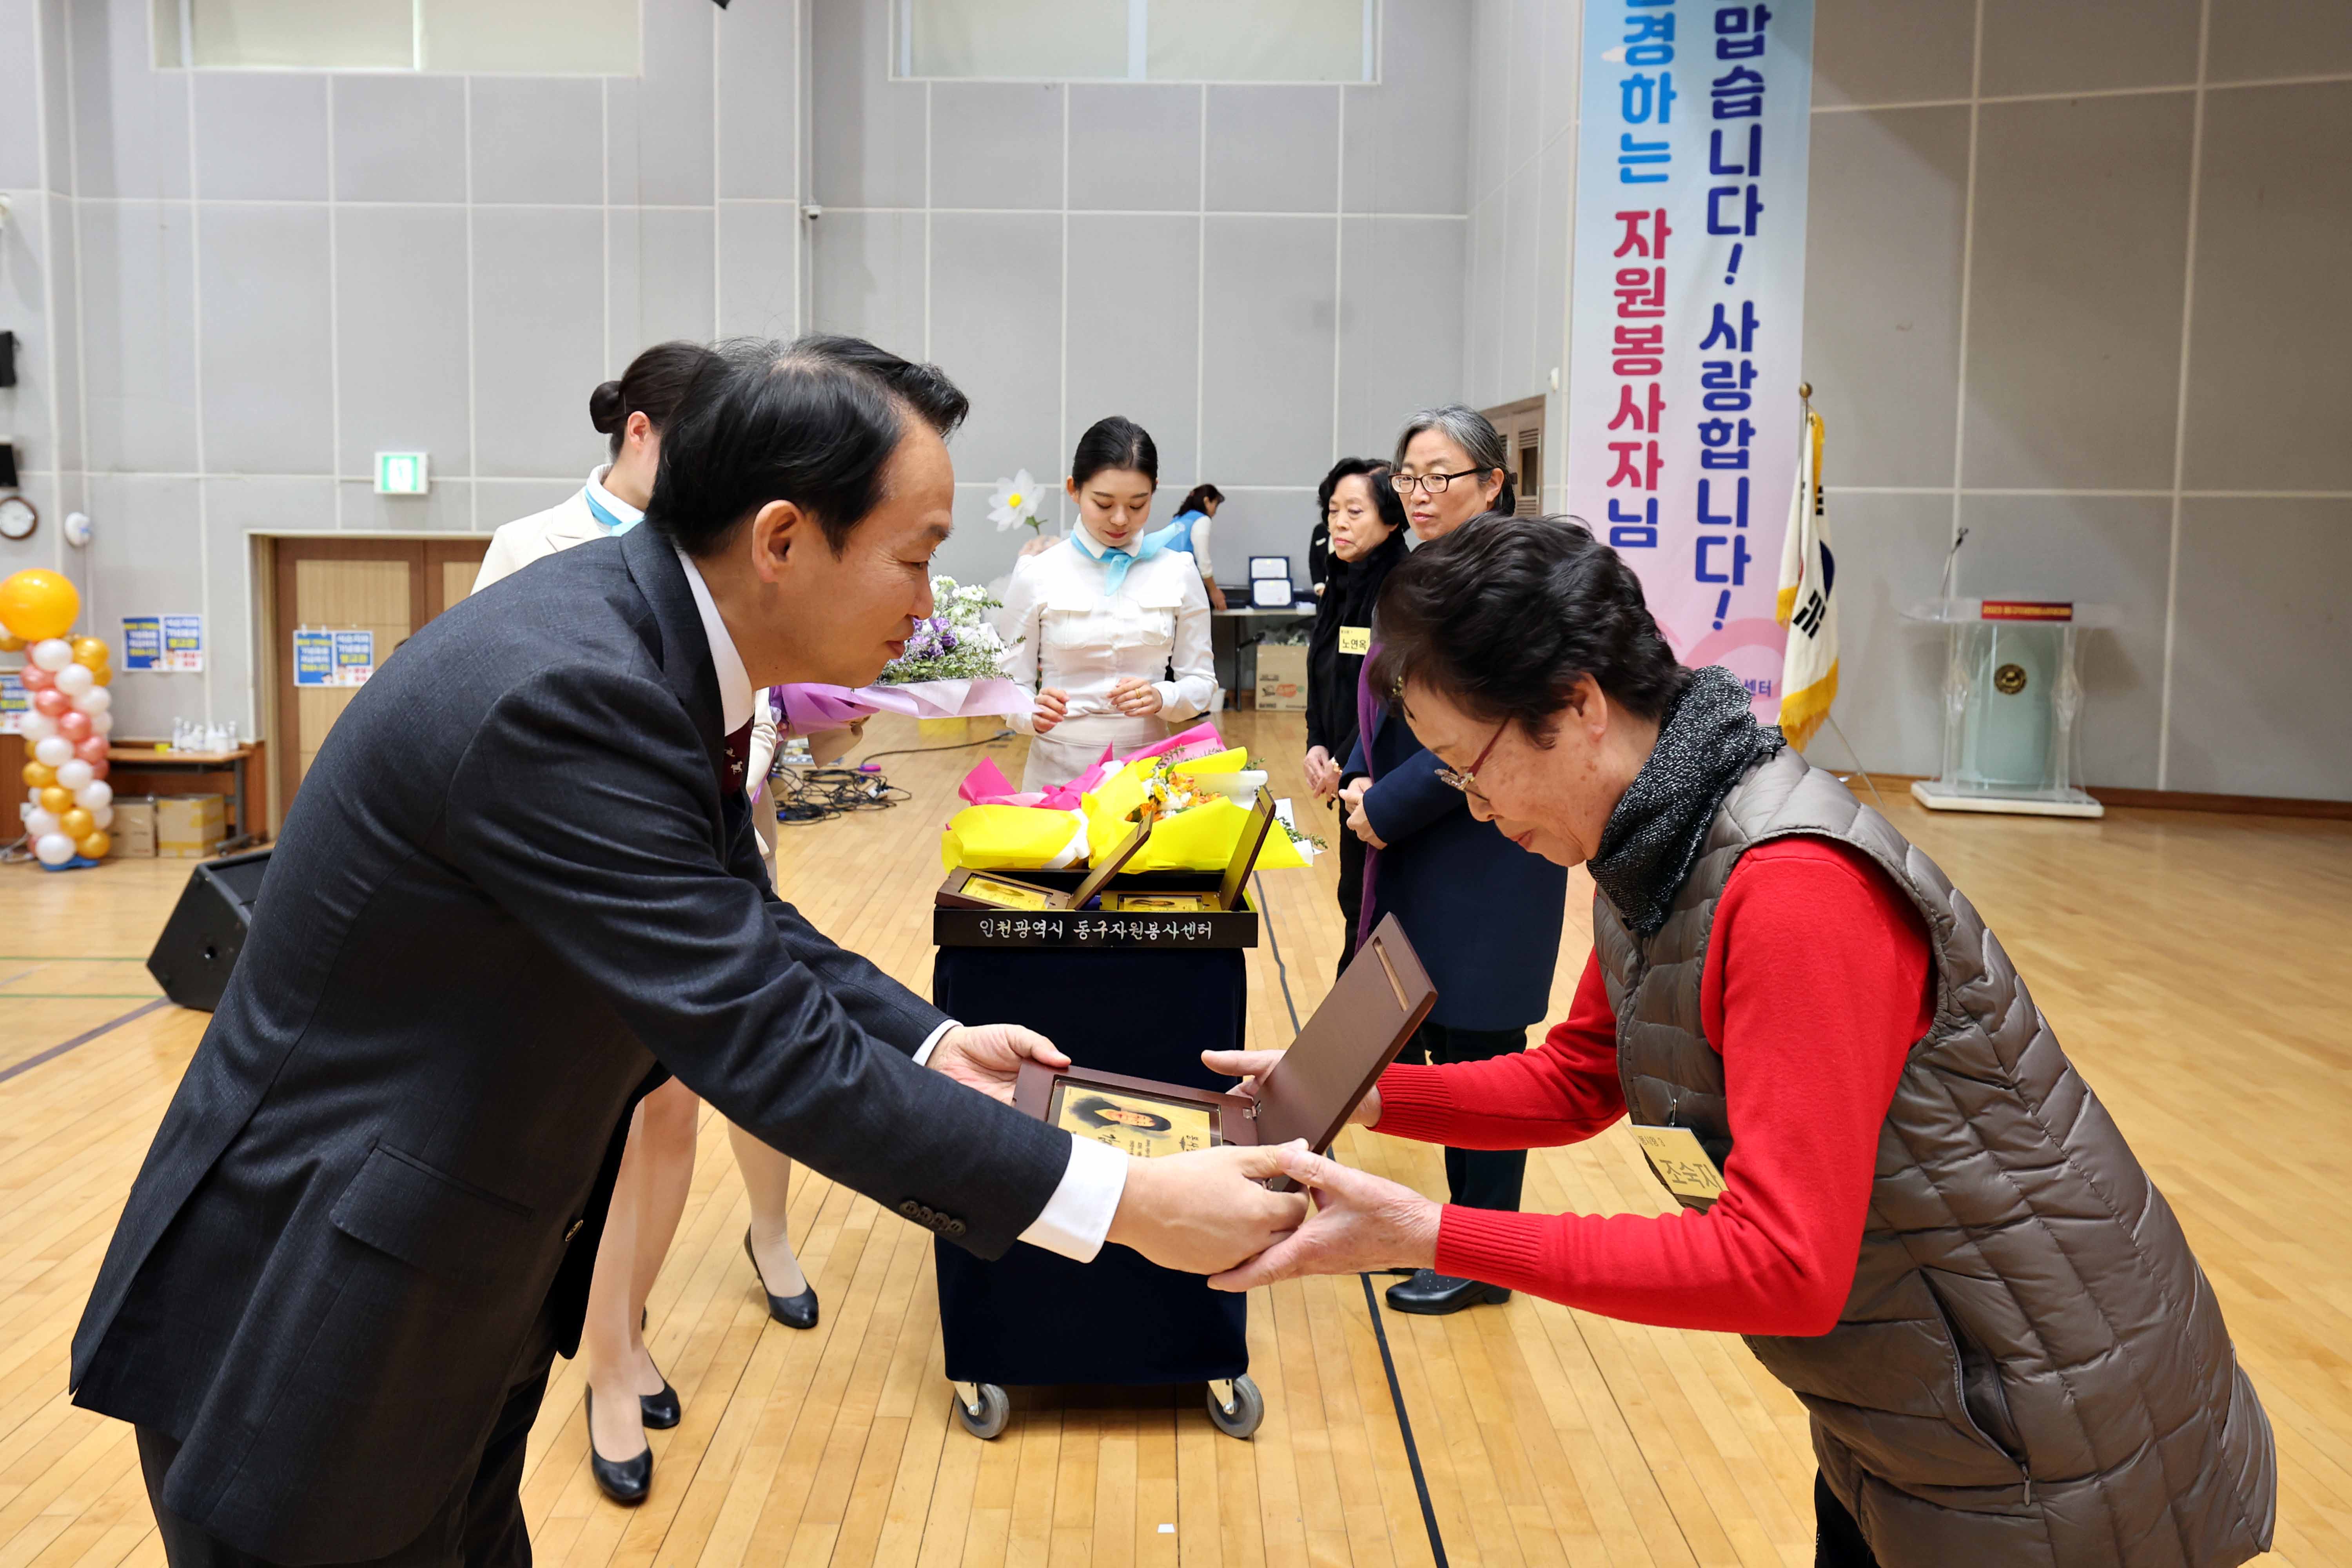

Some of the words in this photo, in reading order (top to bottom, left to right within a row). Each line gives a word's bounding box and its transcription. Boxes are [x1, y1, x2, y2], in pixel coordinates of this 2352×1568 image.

[1617, 0, 1676, 184] 경하는
[1707, 0, 1772, 285] 맙습니다!
[1606, 208, 1672, 548] 자원봉사자님
[1695, 300, 1760, 630] 사랑합니다!
[1342, 638, 1367, 650] 노연옥
[979, 918, 1063, 939] 인천광역시
[1073, 920, 1212, 941] 동구자원봉사센터
[1659, 1158, 1723, 1191] 조숙자
